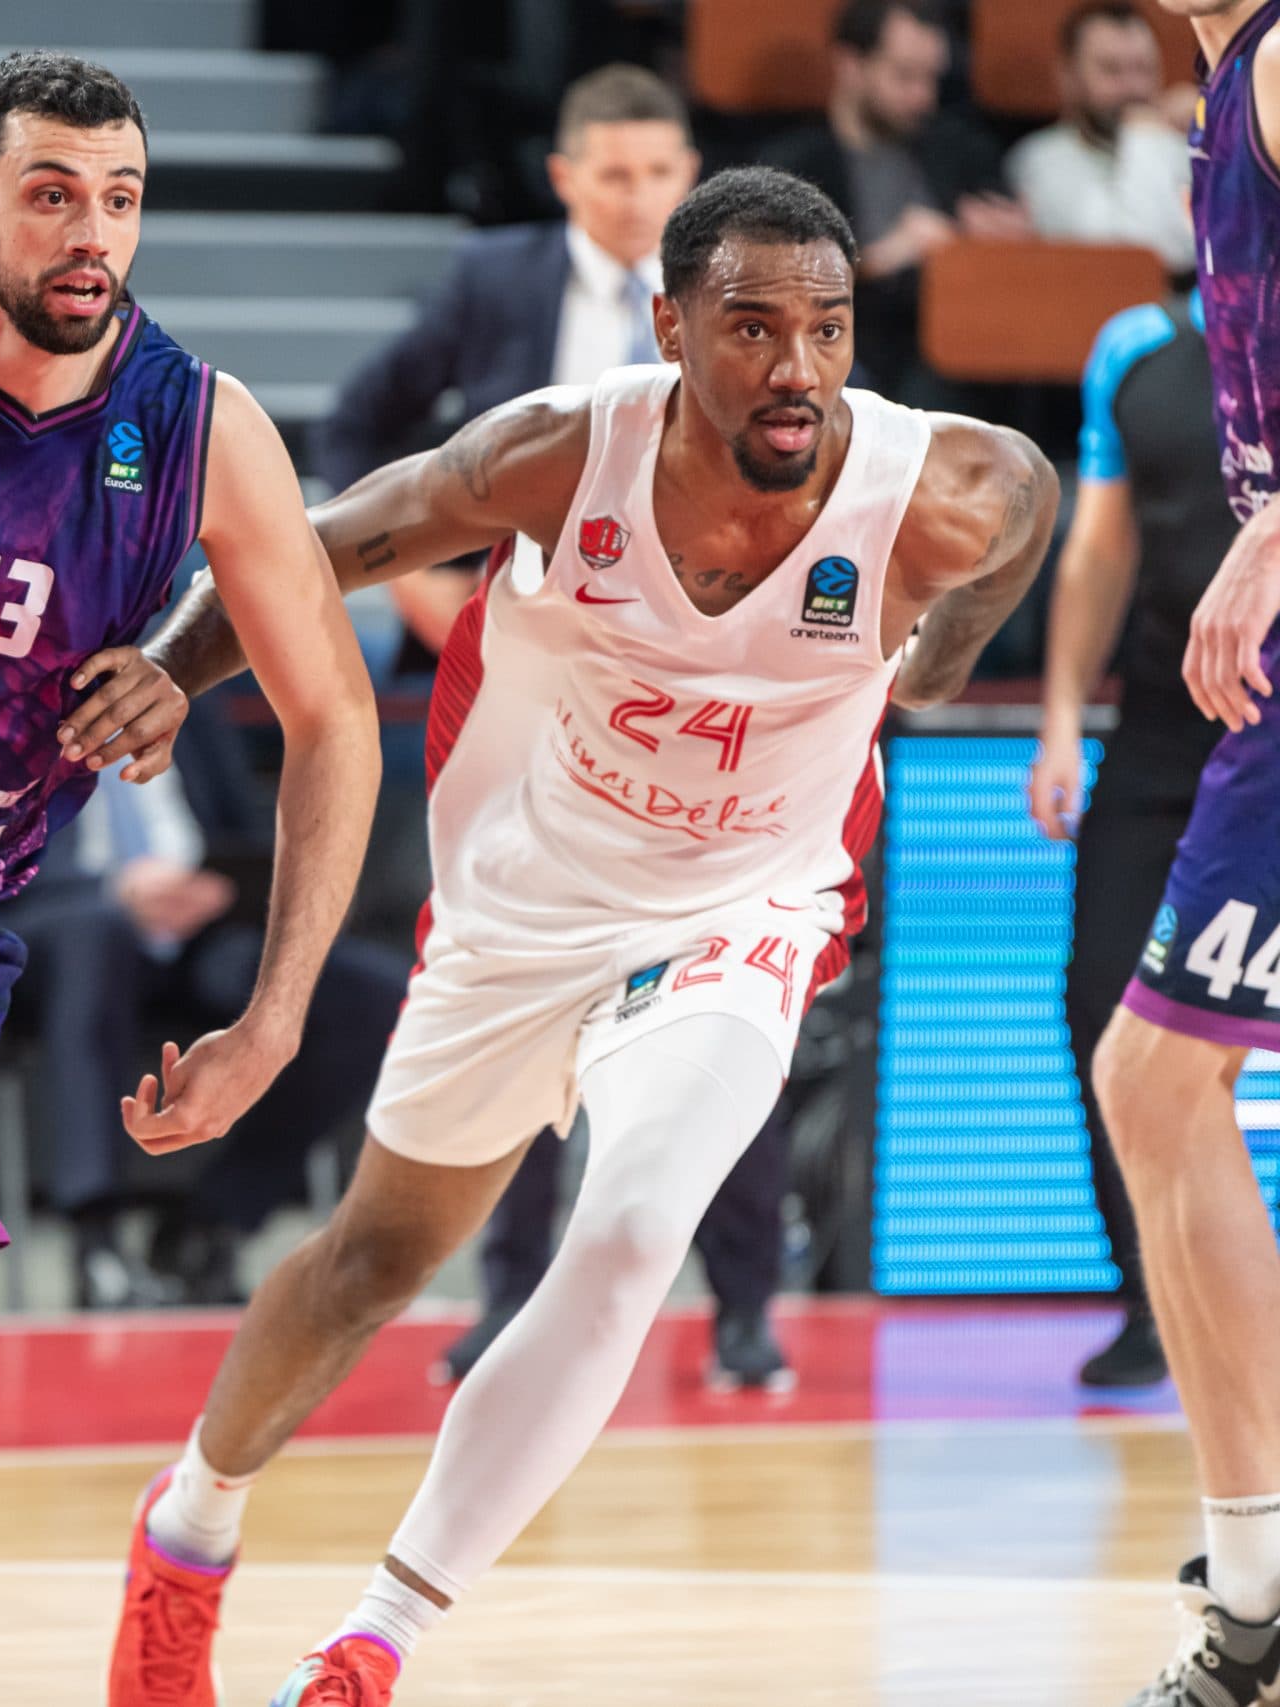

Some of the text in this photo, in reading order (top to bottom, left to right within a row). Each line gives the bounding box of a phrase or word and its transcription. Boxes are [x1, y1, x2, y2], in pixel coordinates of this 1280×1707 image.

[105, 477, 143, 492] EuroCup
[790, 628, 859, 643] oneteam
[804, 609, 850, 624] EuroCup
[609, 679, 753, 773] 24
[672, 936, 799, 1021] 24
[1185, 898, 1280, 1009] 44
